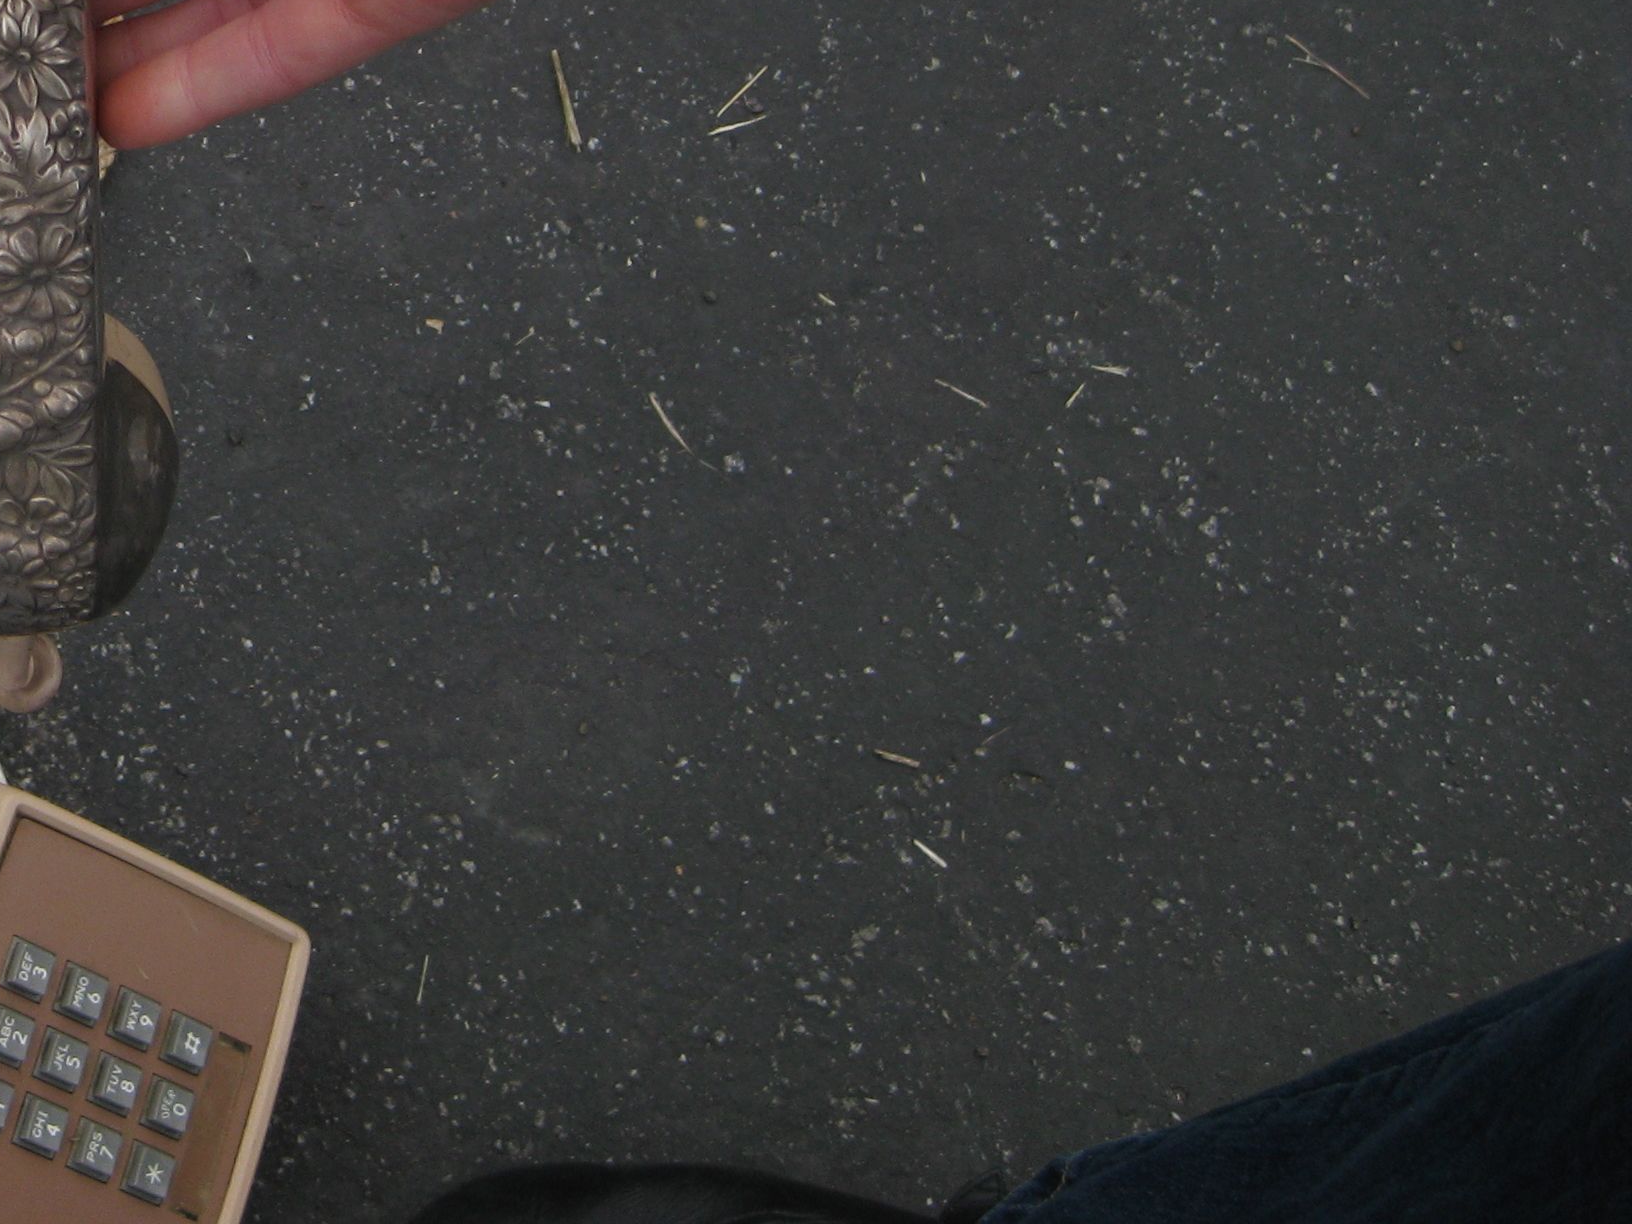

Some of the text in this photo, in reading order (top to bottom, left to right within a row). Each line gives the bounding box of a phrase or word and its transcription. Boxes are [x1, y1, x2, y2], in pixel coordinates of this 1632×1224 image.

[18, 951, 34, 982] DEF
[32, 966, 48, 980] 3
[72, 976, 89, 1008] MNO
[87, 992, 101, 1004] 6
[126, 1000, 142, 1031] WXY
[139, 1015, 154, 1026] 9
[0, 1016, 15, 1048] ABC
[12, 1031, 28, 1045] 2
[53, 1044, 70, 1071] JKL
[65, 1055, 81, 1069] 5
[106, 1064, 123, 1093] TUV
[120, 1079, 135, 1093] 8
[32, 1110, 48, 1138] GHI
[47, 1124, 61, 1136] 4
[86, 1132, 102, 1163] PRS
[99, 1145, 115, 1161] 7
